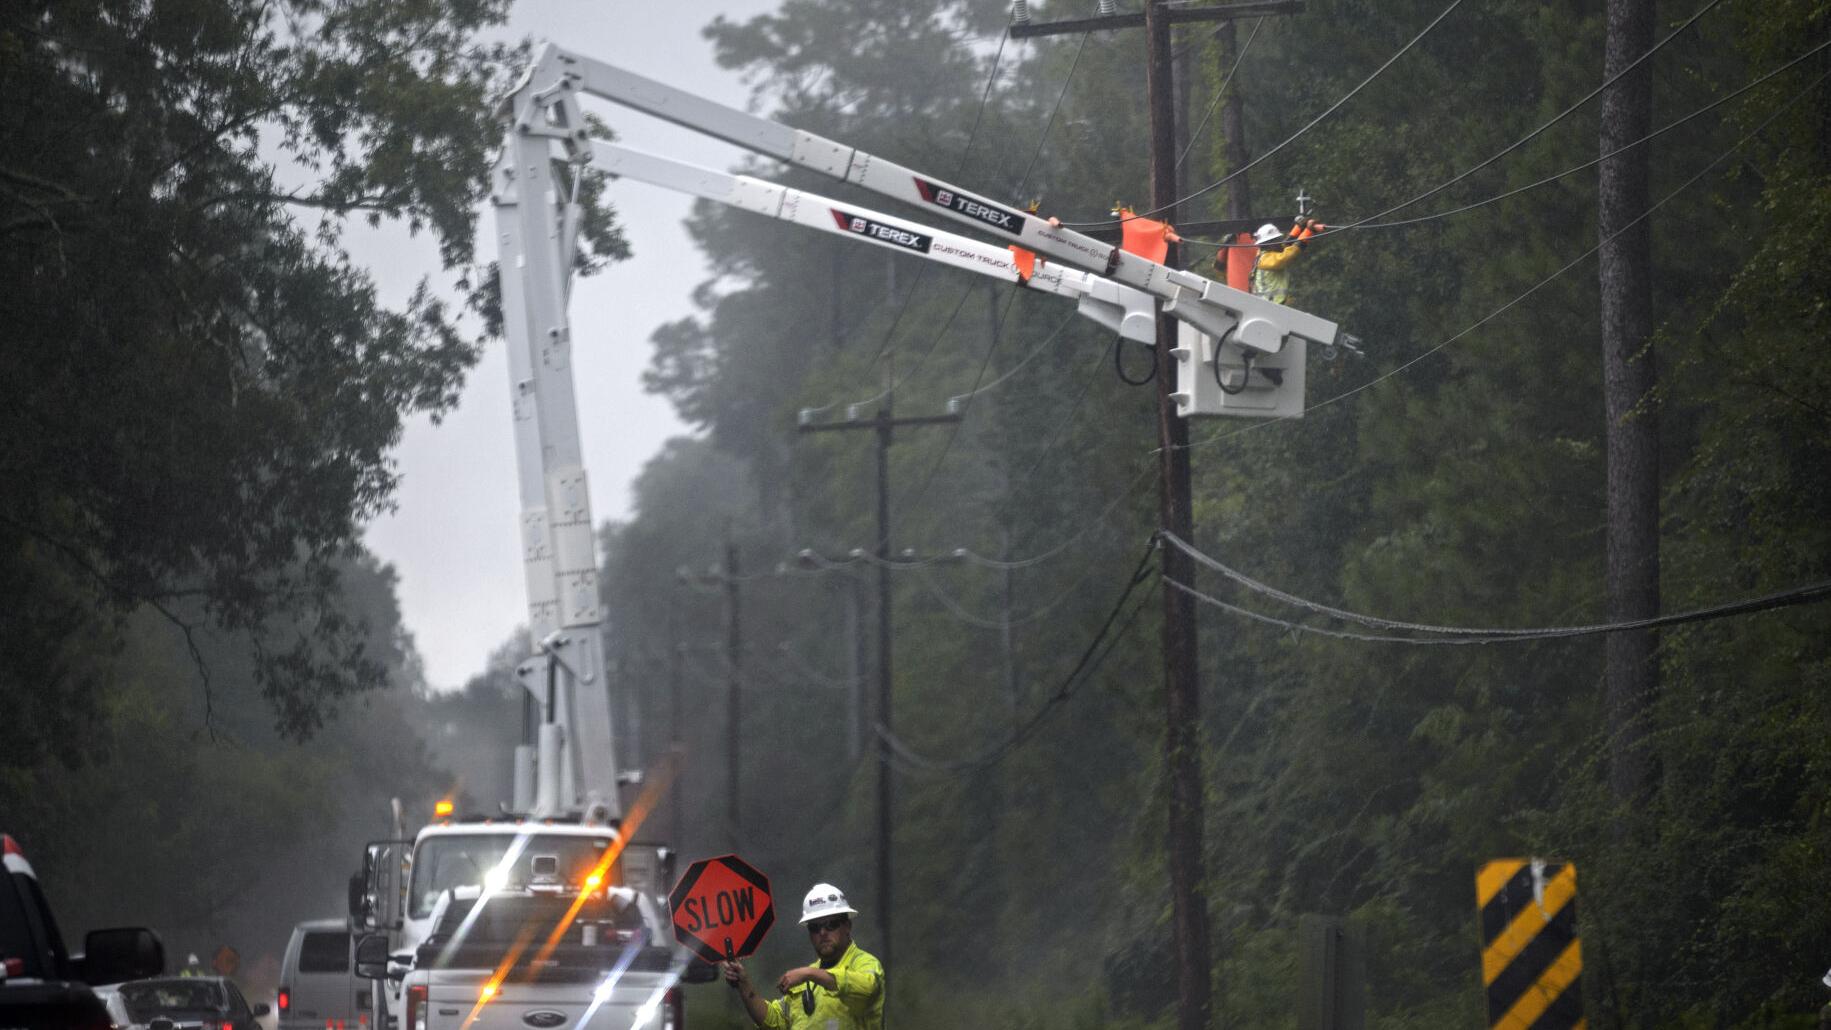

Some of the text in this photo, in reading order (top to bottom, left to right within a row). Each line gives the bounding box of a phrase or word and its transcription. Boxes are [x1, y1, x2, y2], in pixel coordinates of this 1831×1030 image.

[957, 196, 1012, 228] TEREX
[869, 223, 920, 247] TEREX
[933, 242, 976, 260] CUSTOM
[977, 255, 1009, 269] TRUCK
[684, 886, 755, 933] SLOW
